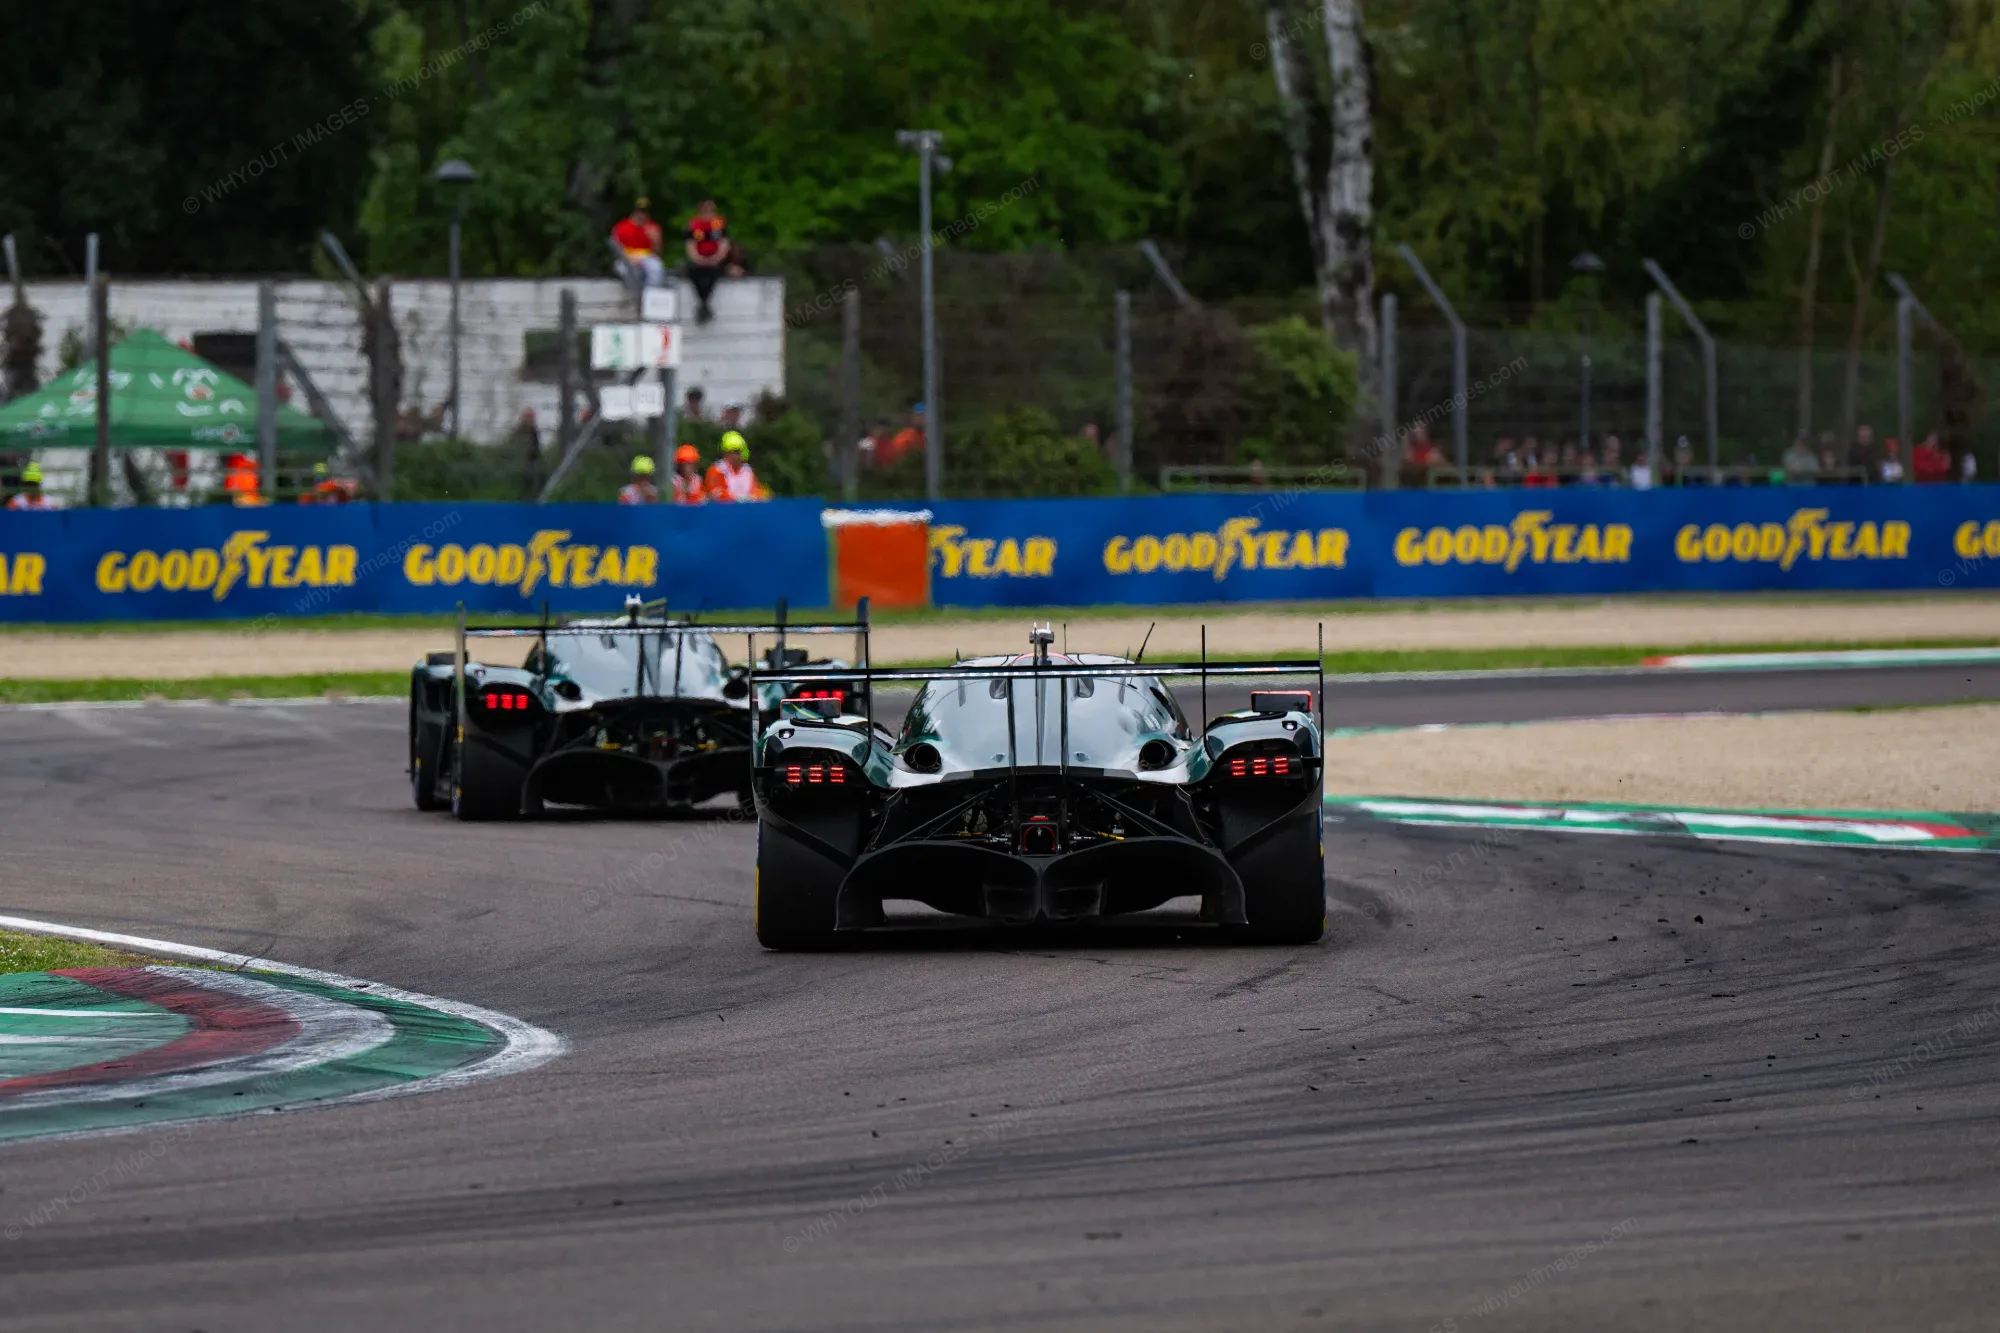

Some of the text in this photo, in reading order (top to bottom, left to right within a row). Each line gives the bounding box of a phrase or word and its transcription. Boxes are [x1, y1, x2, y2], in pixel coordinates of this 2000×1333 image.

[96, 531, 357, 600] GOODYEAR
[403, 530, 658, 595] GOODYEAR
[1103, 518, 1349, 578] GOODYEAR
[1395, 511, 1633, 571] GOODYEAR
[1675, 509, 1911, 569] GOODYEAR
